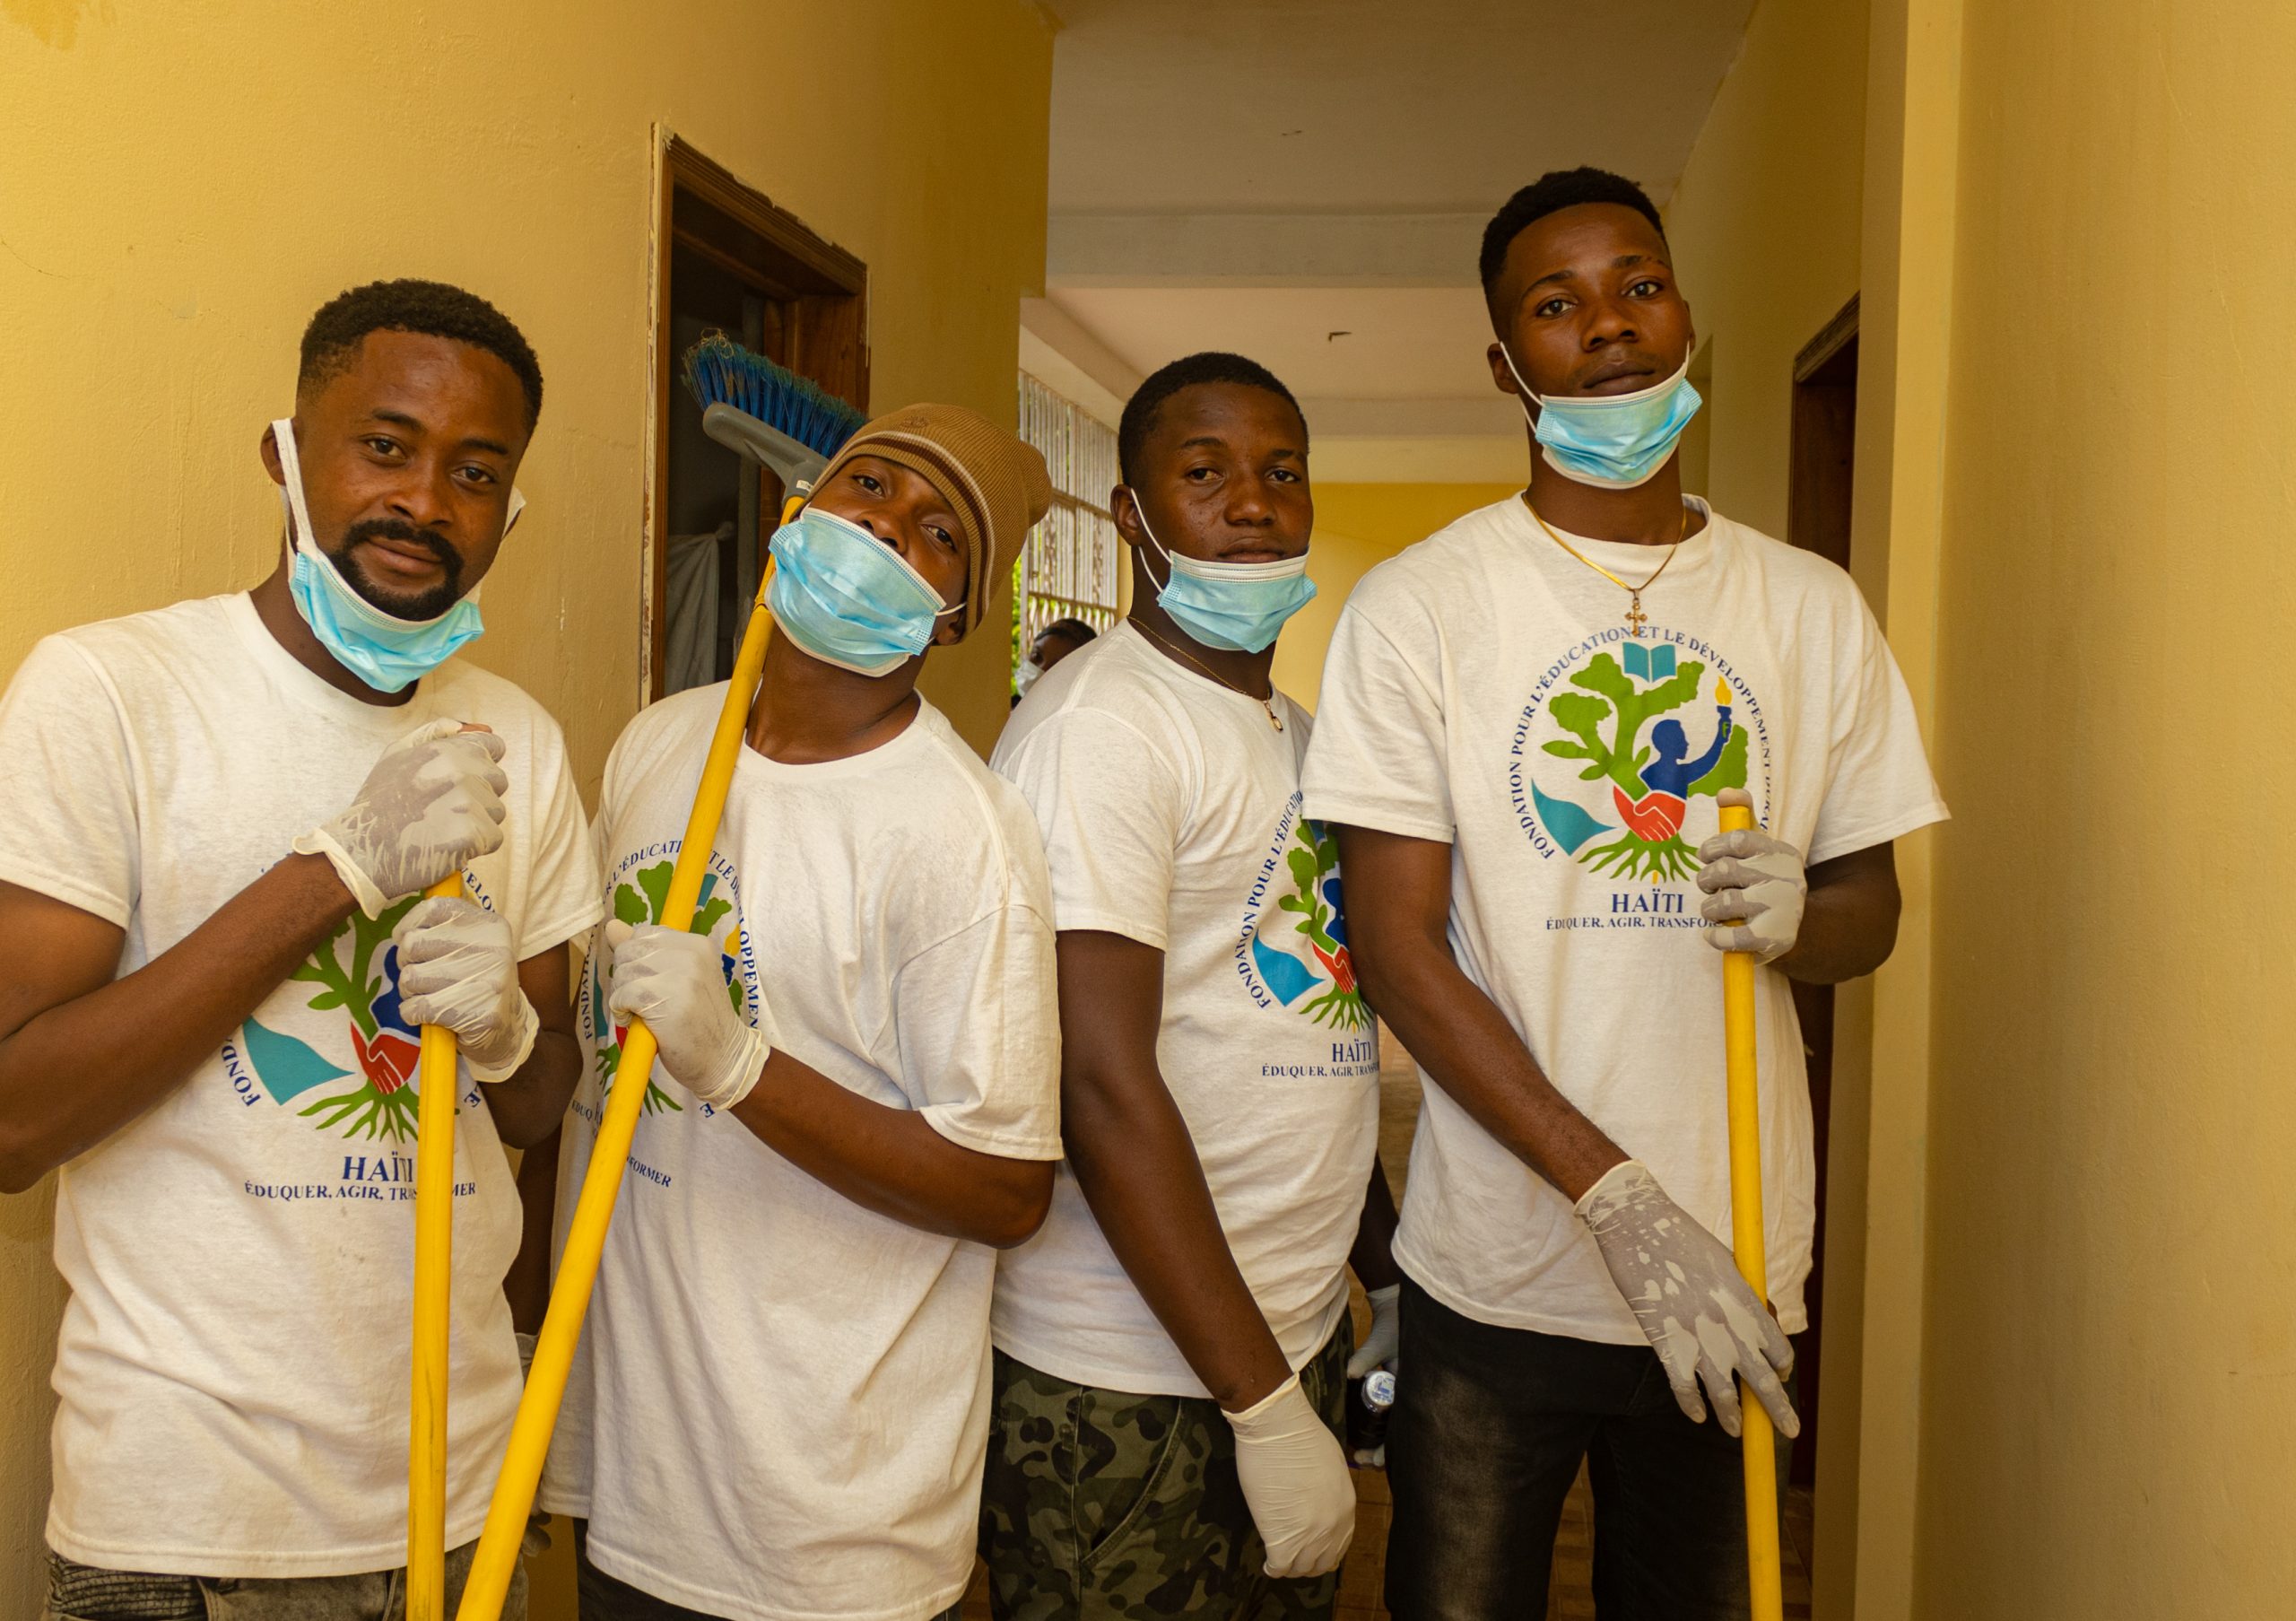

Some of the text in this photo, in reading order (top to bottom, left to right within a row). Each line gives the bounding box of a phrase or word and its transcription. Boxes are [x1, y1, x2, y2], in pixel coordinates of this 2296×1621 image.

[1638, 626, 1660, 639] ET
[1665, 629, 1686, 645] LE
[1511, 705, 1535, 755] POUR
[1509, 761, 1555, 858] FONDATION
[613, 841, 683, 882] L'ÉDUCATI
[716, 858, 735, 880] LE
[1248, 858, 1277, 908] POUR
[1271, 790, 1303, 856] L'ÉDUCATIO
[1612, 888, 1684, 913] HAÏTI
[1650, 915, 1718, 929] TRANSFO
[1332, 1038, 1371, 1063] HAÏTI
[627, 1155, 672, 1188] FORMER
